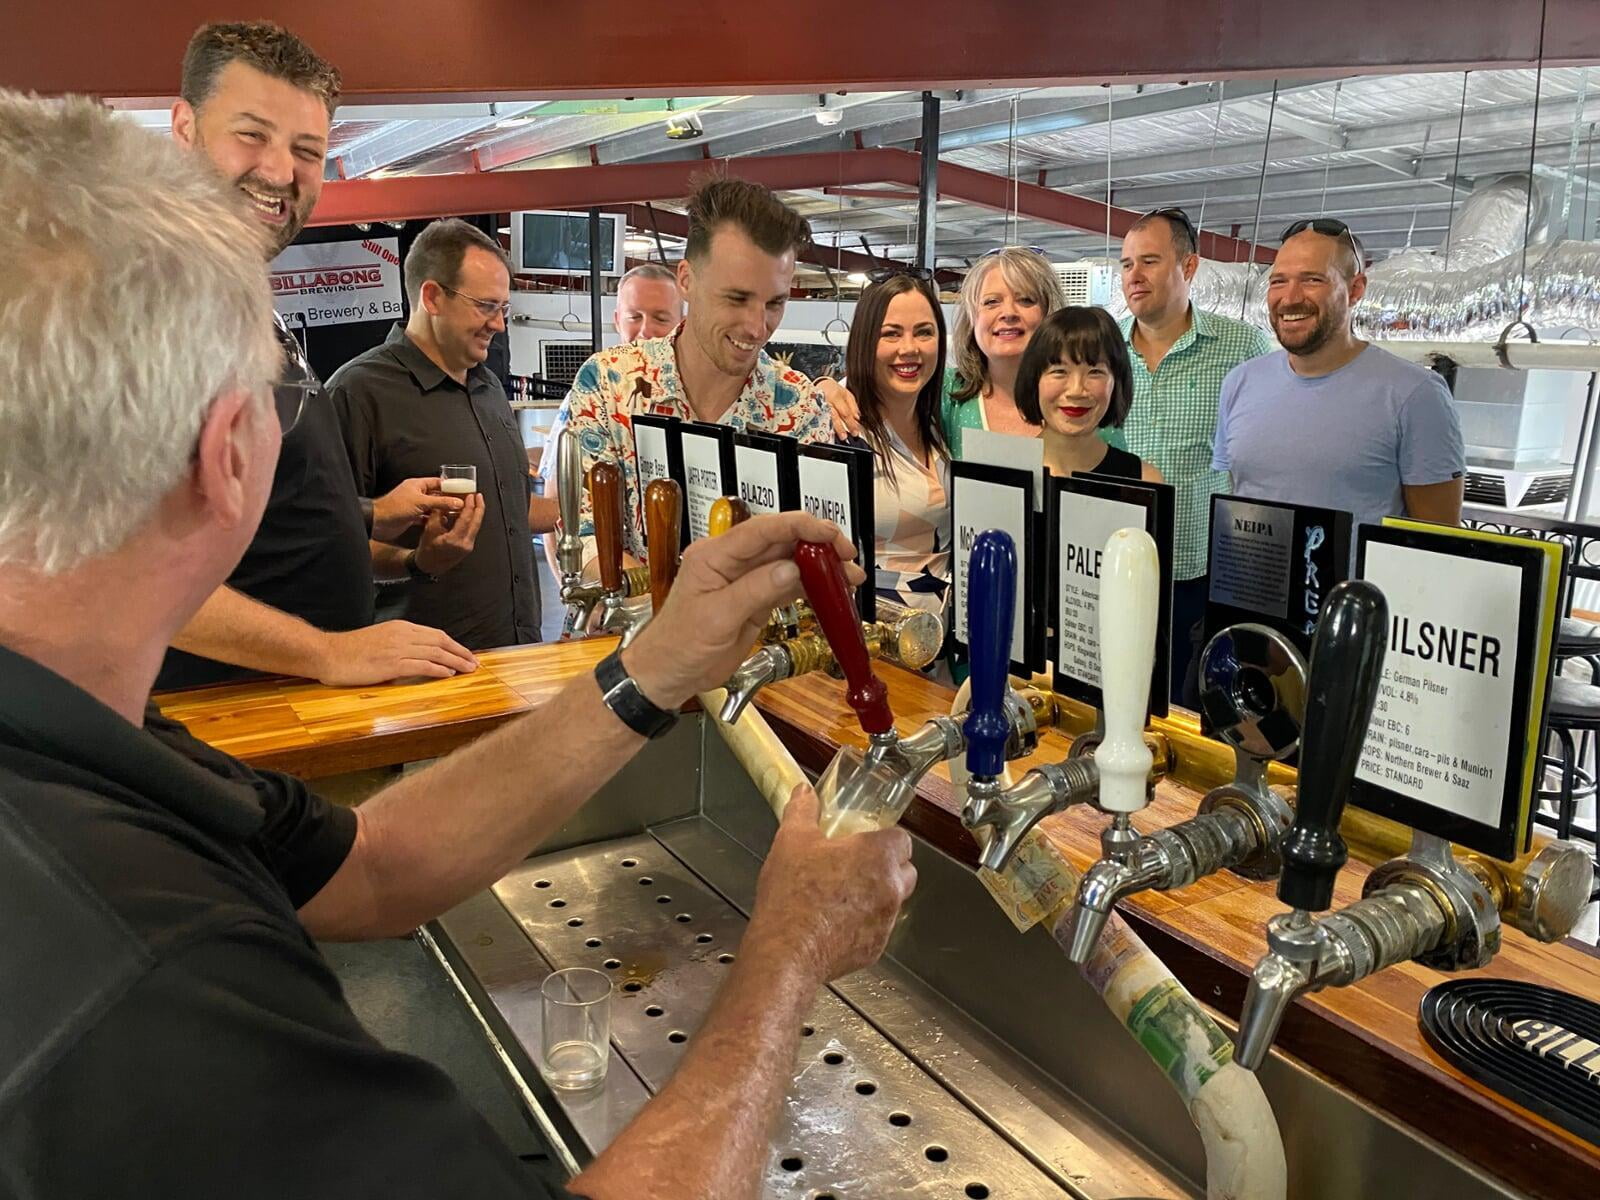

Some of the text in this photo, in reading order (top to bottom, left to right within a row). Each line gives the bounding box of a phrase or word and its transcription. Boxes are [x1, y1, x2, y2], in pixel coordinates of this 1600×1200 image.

[361, 239, 382, 255] Still
[267, 269, 382, 291] BILLABONG
[300, 284, 355, 295] BREWING
[281, 312, 303, 323] cro
[308, 305, 364, 321] Brewery
[369, 302, 378, 314] &
[741, 481, 774, 508] BLAZ3D
[821, 499, 846, 525] NEIPA
[1234, 518, 1273, 537] NEIPA
[1067, 543, 1102, 579] PALE
[1391, 615, 1500, 677] ILSNER
[1393, 670, 1421, 688] German
[1422, 678, 1448, 696] Pilsner
[1399, 690, 1419, 704] 4.8%
[1387, 719, 1404, 733] EBC:
[1405, 724, 1411, 736] 6
[1367, 729, 1387, 744] RAIN:
[1452, 756, 1458, 768] &
[1461, 759, 1493, 780] Munich1
[1361, 759, 1424, 790] PRICE: STANDARD
[1385, 751, 1414, 770] Northern
[1416, 761, 1442, 779] Brewer
[1444, 771, 1449, 782] &
[1452, 773, 1470, 789] Saaz
